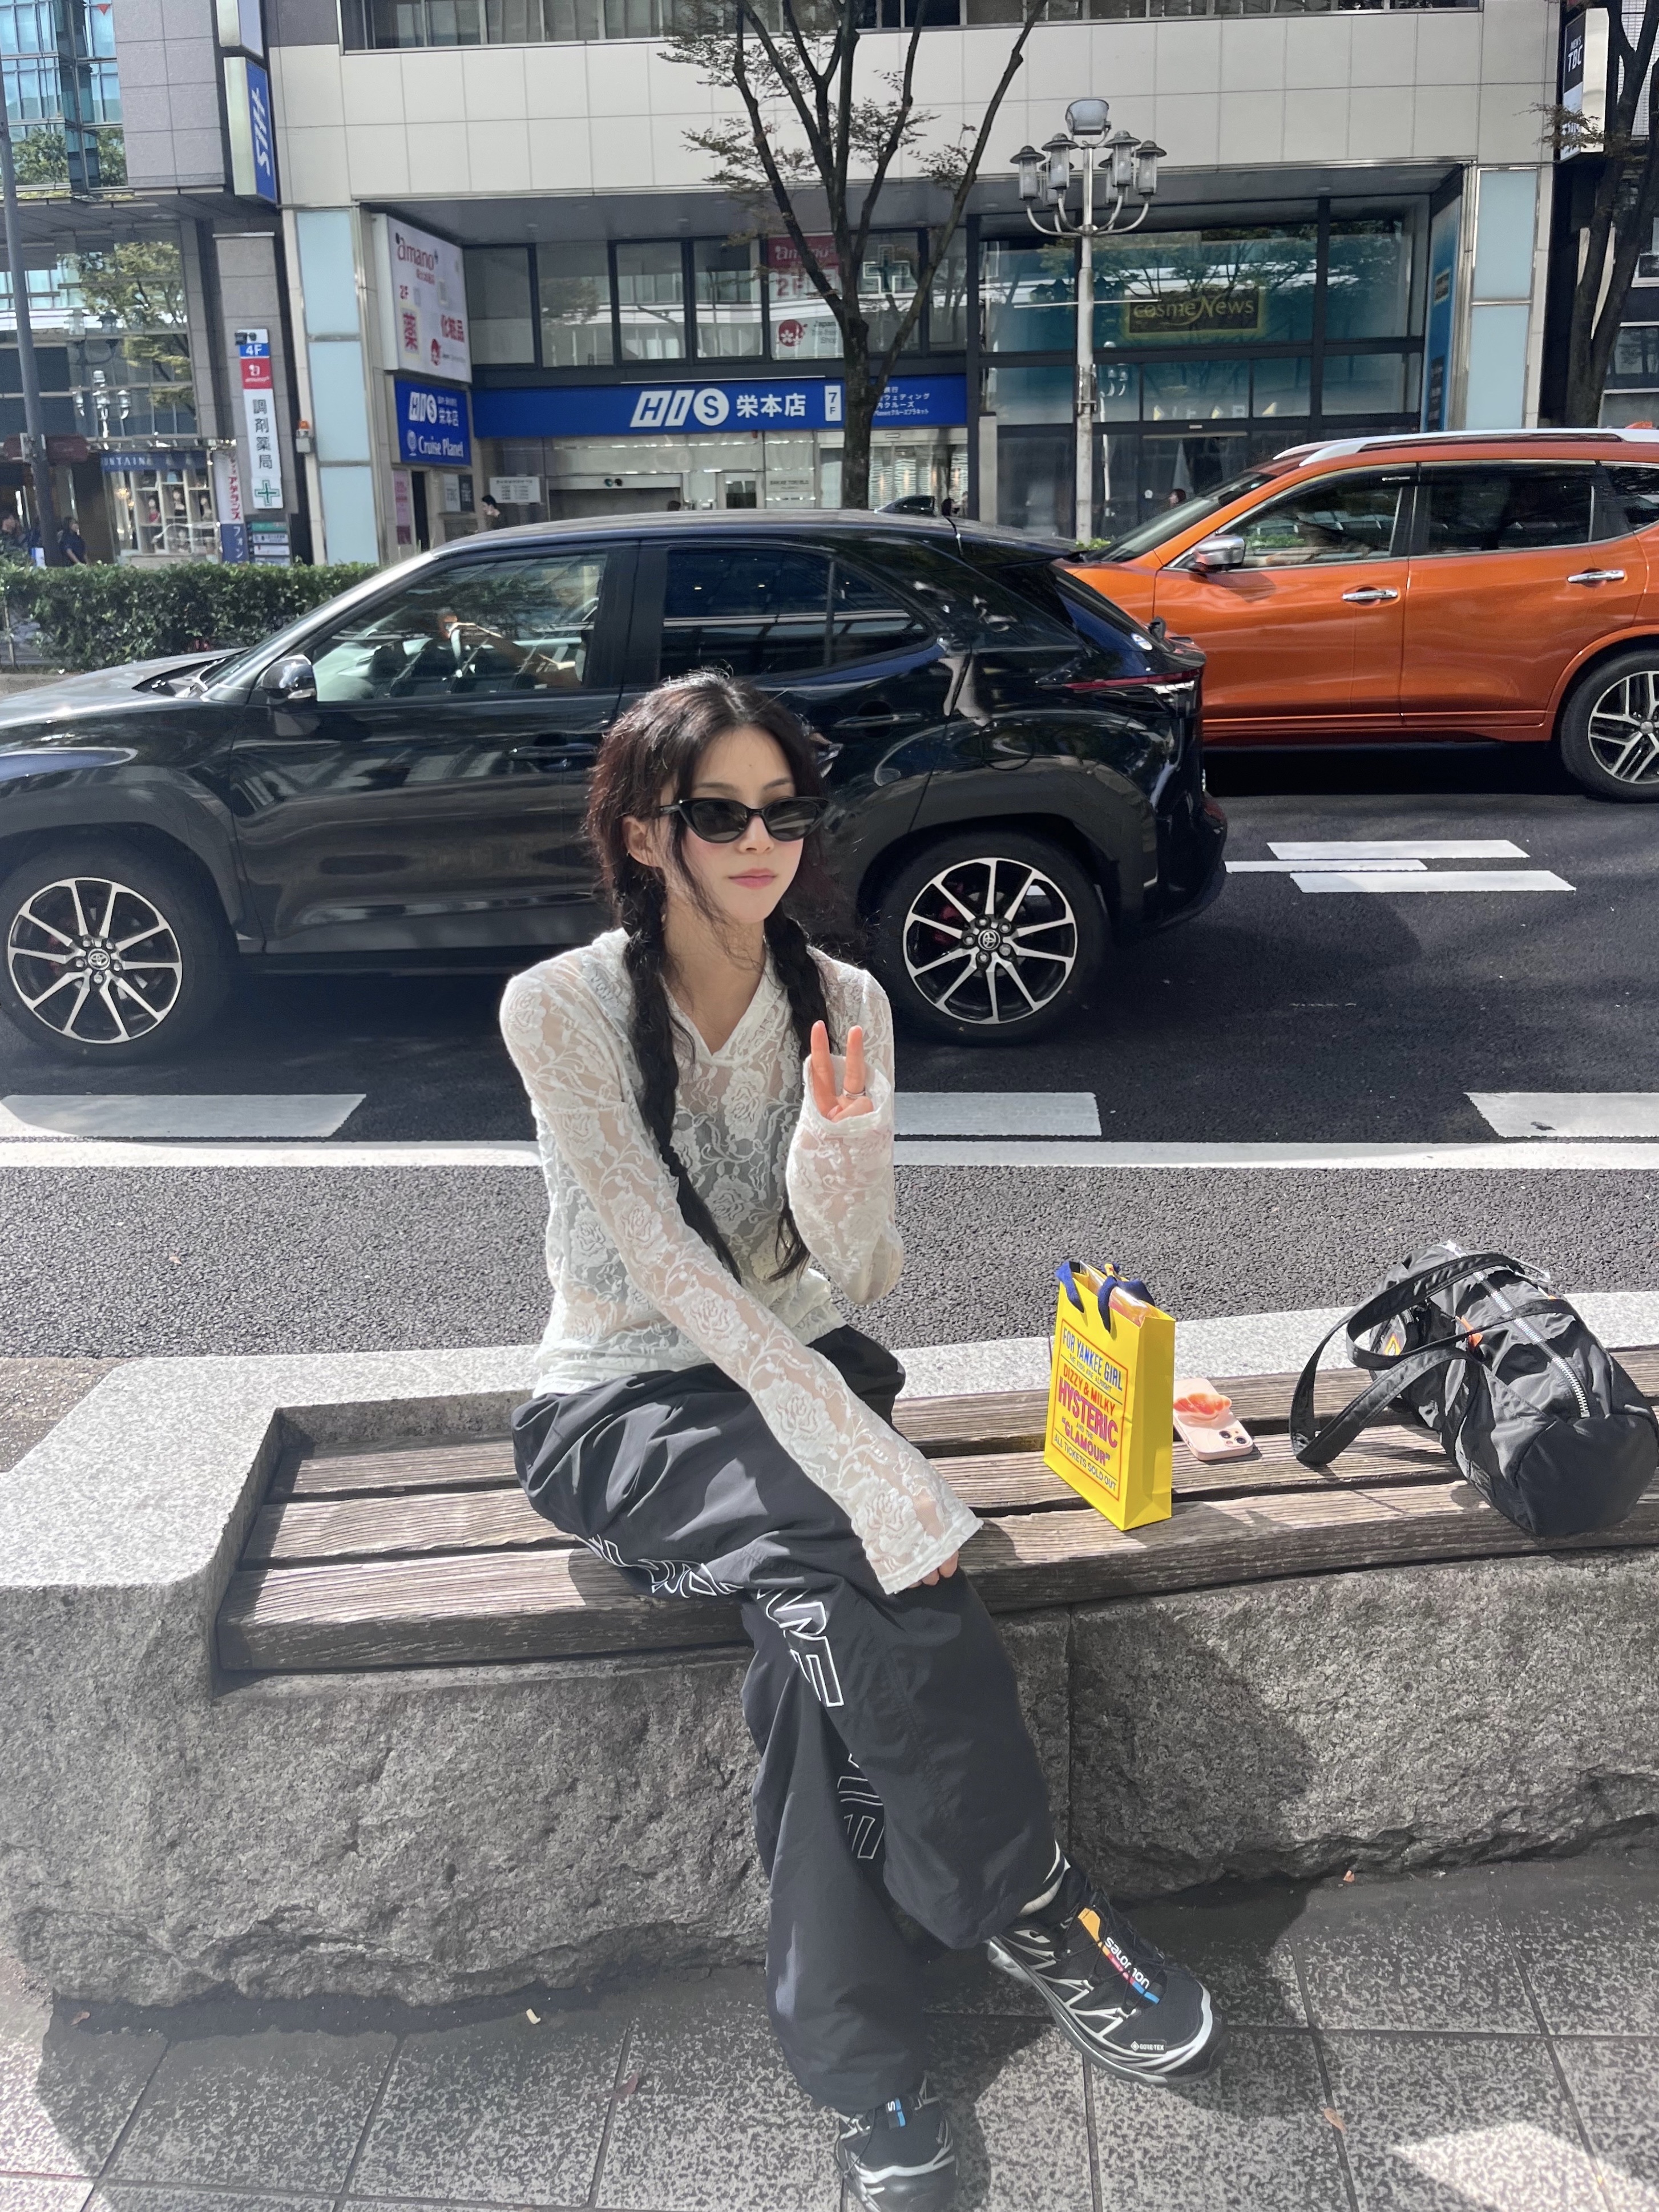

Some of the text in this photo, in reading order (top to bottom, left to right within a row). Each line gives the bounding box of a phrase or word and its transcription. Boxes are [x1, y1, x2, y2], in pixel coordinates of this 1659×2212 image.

[1568, 45, 1583, 72] TBC
[245, 344, 263, 356] 4F
[736, 393, 806, 418] 栄本店
[829, 392, 838, 403] 7
[830, 406, 835, 415] F
[438, 407, 459, 427] 栄本店
[252, 399, 273, 469] 調剤薬局
[418, 435, 464, 458] Cruise Planet
[1063, 1326, 1123, 1391] FOR YANKEE GIRL
[1076, 1359, 1085, 1372] KIDS
[1085, 1369, 1094, 1379] ARE
[1095, 1376, 1112, 1392] ALRIGHT
[1063, 1363, 1116, 1416] DIZZY & MILKY
[1059, 1375, 1119, 1448] HYSTERIC
[1054, 1434, 1117, 1491] ALL TICKETS SOLD OUT
